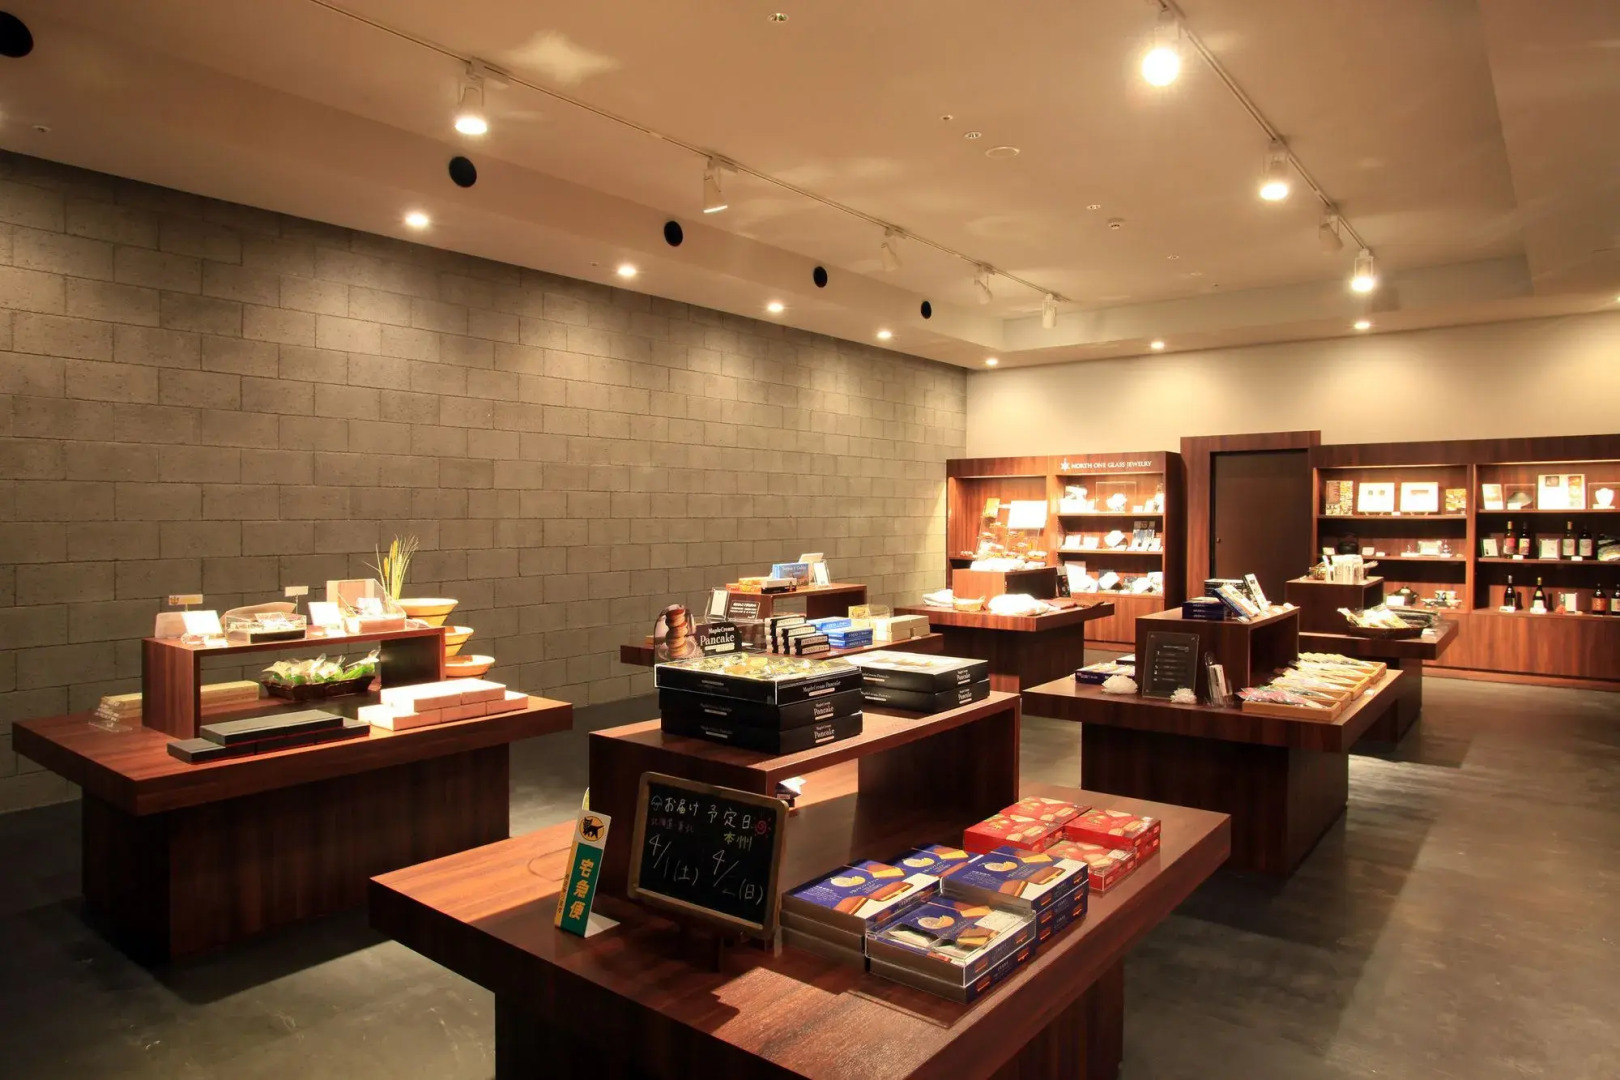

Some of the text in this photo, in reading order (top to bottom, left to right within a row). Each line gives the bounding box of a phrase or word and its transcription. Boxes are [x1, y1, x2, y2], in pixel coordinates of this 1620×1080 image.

[1126, 460, 1152, 468] JEWELRY
[700, 632, 735, 646] Pancake
[813, 705, 834, 716] Pancake
[814, 728, 835, 739] Pancake
[723, 831, 753, 852] 本州
[568, 858, 595, 921] 宅急便
